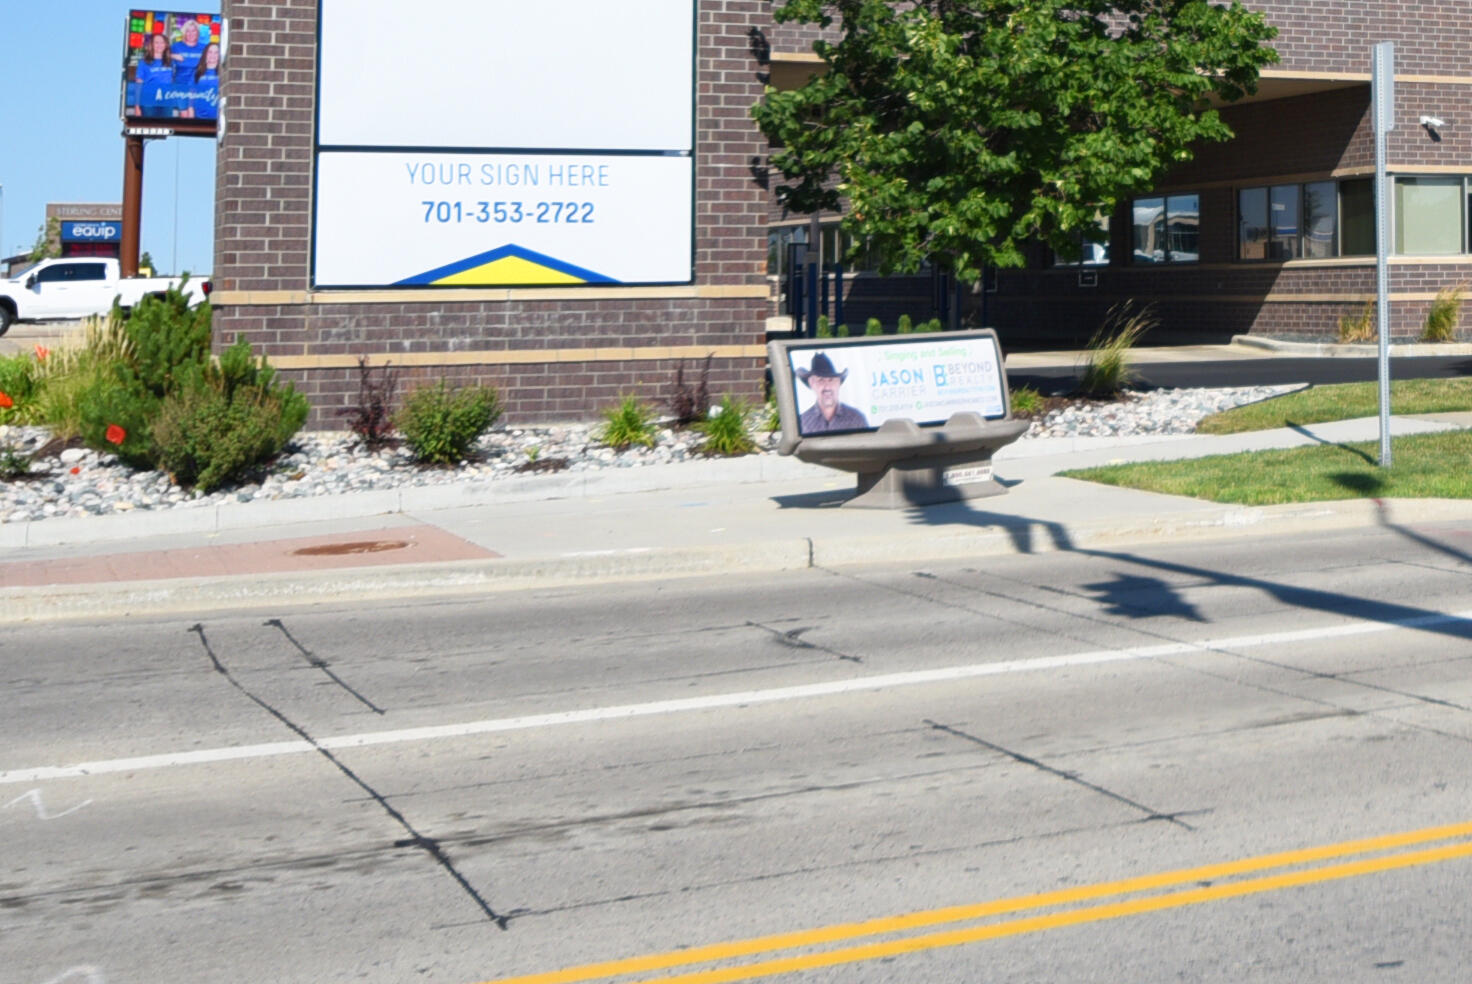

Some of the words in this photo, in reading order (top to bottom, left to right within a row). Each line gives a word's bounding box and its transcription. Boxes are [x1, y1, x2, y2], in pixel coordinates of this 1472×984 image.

[164, 88, 218, 107] community
[405, 162, 472, 185] YOUR
[480, 164, 540, 186] SIGN
[548, 165, 610, 187] HERE
[421, 201, 595, 223] 701-353-2722
[871, 368, 924, 387] JASON
[947, 361, 992, 375] BEYOND
